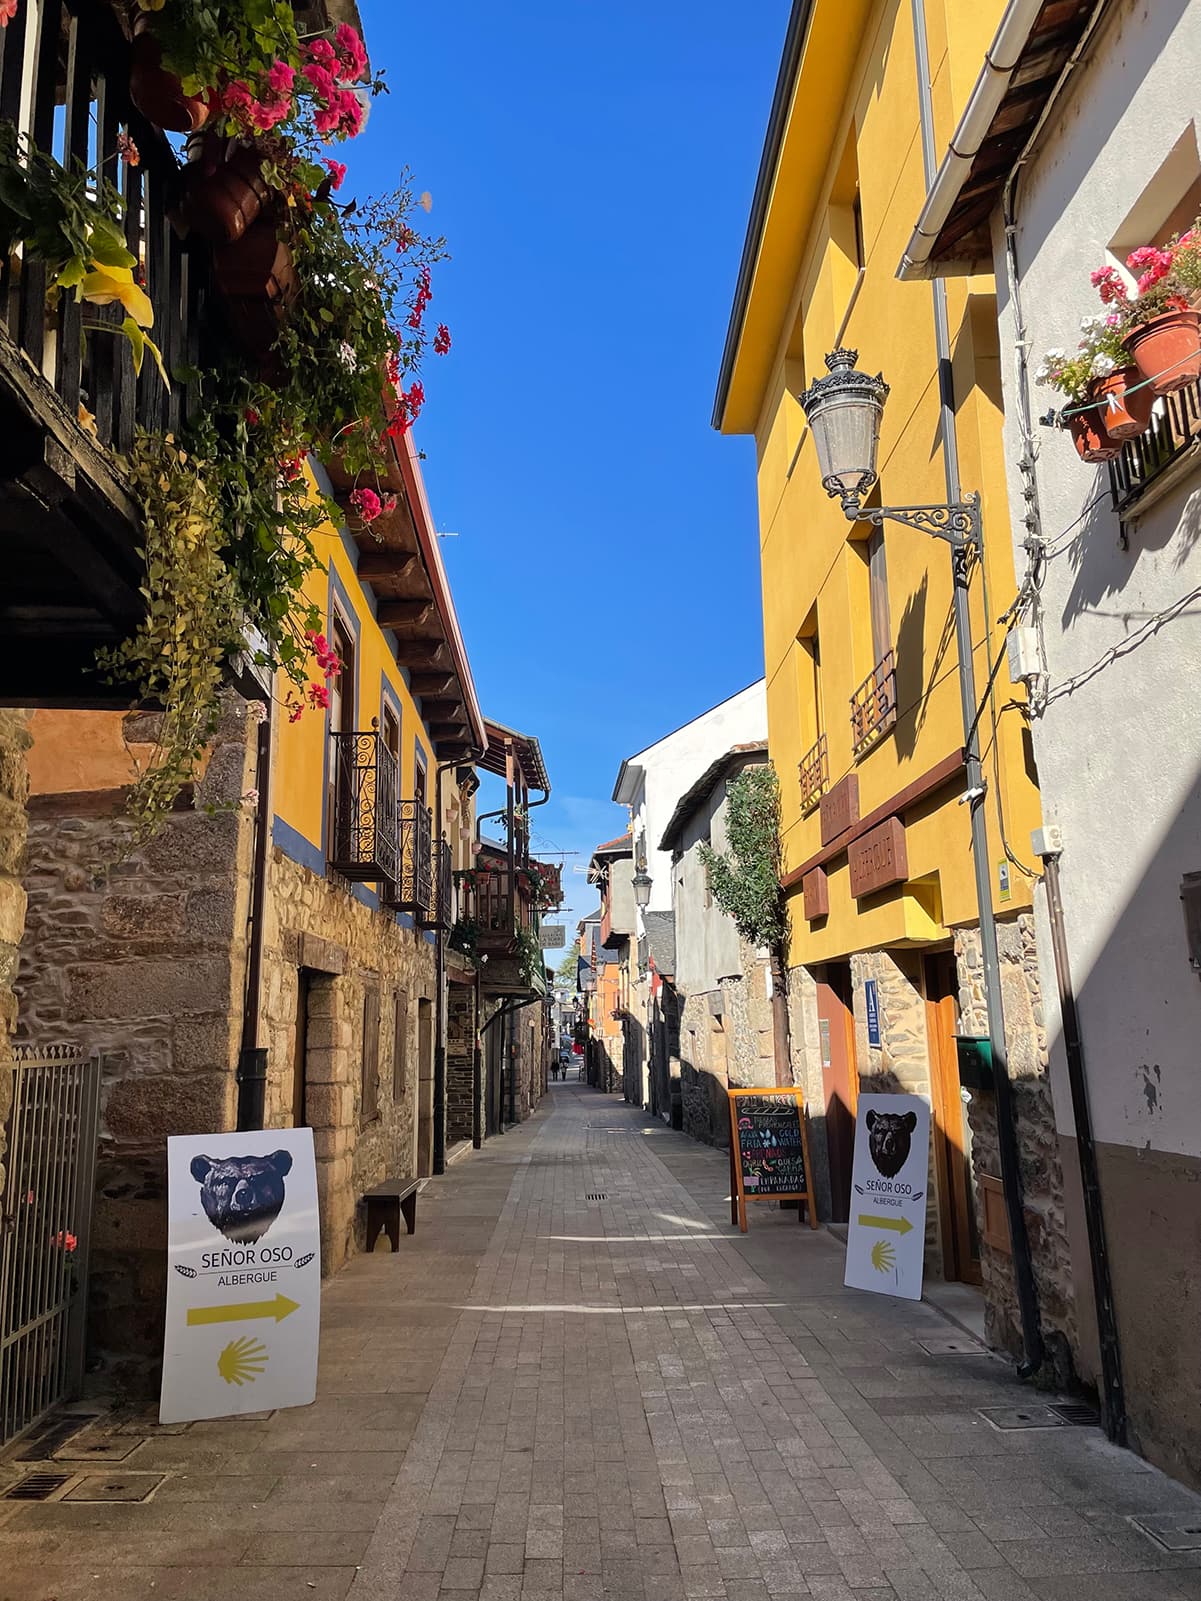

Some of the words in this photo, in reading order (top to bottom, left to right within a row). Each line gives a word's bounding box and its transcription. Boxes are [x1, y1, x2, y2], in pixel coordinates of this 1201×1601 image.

[866, 1178, 893, 1193] SEÑOR
[894, 1183, 912, 1195] OSO
[873, 1197, 903, 1208] ALBERGUE
[201, 1249, 256, 1268] SEÑOR
[260, 1246, 293, 1263] OSO
[217, 1271, 277, 1287] ALBERGUE
